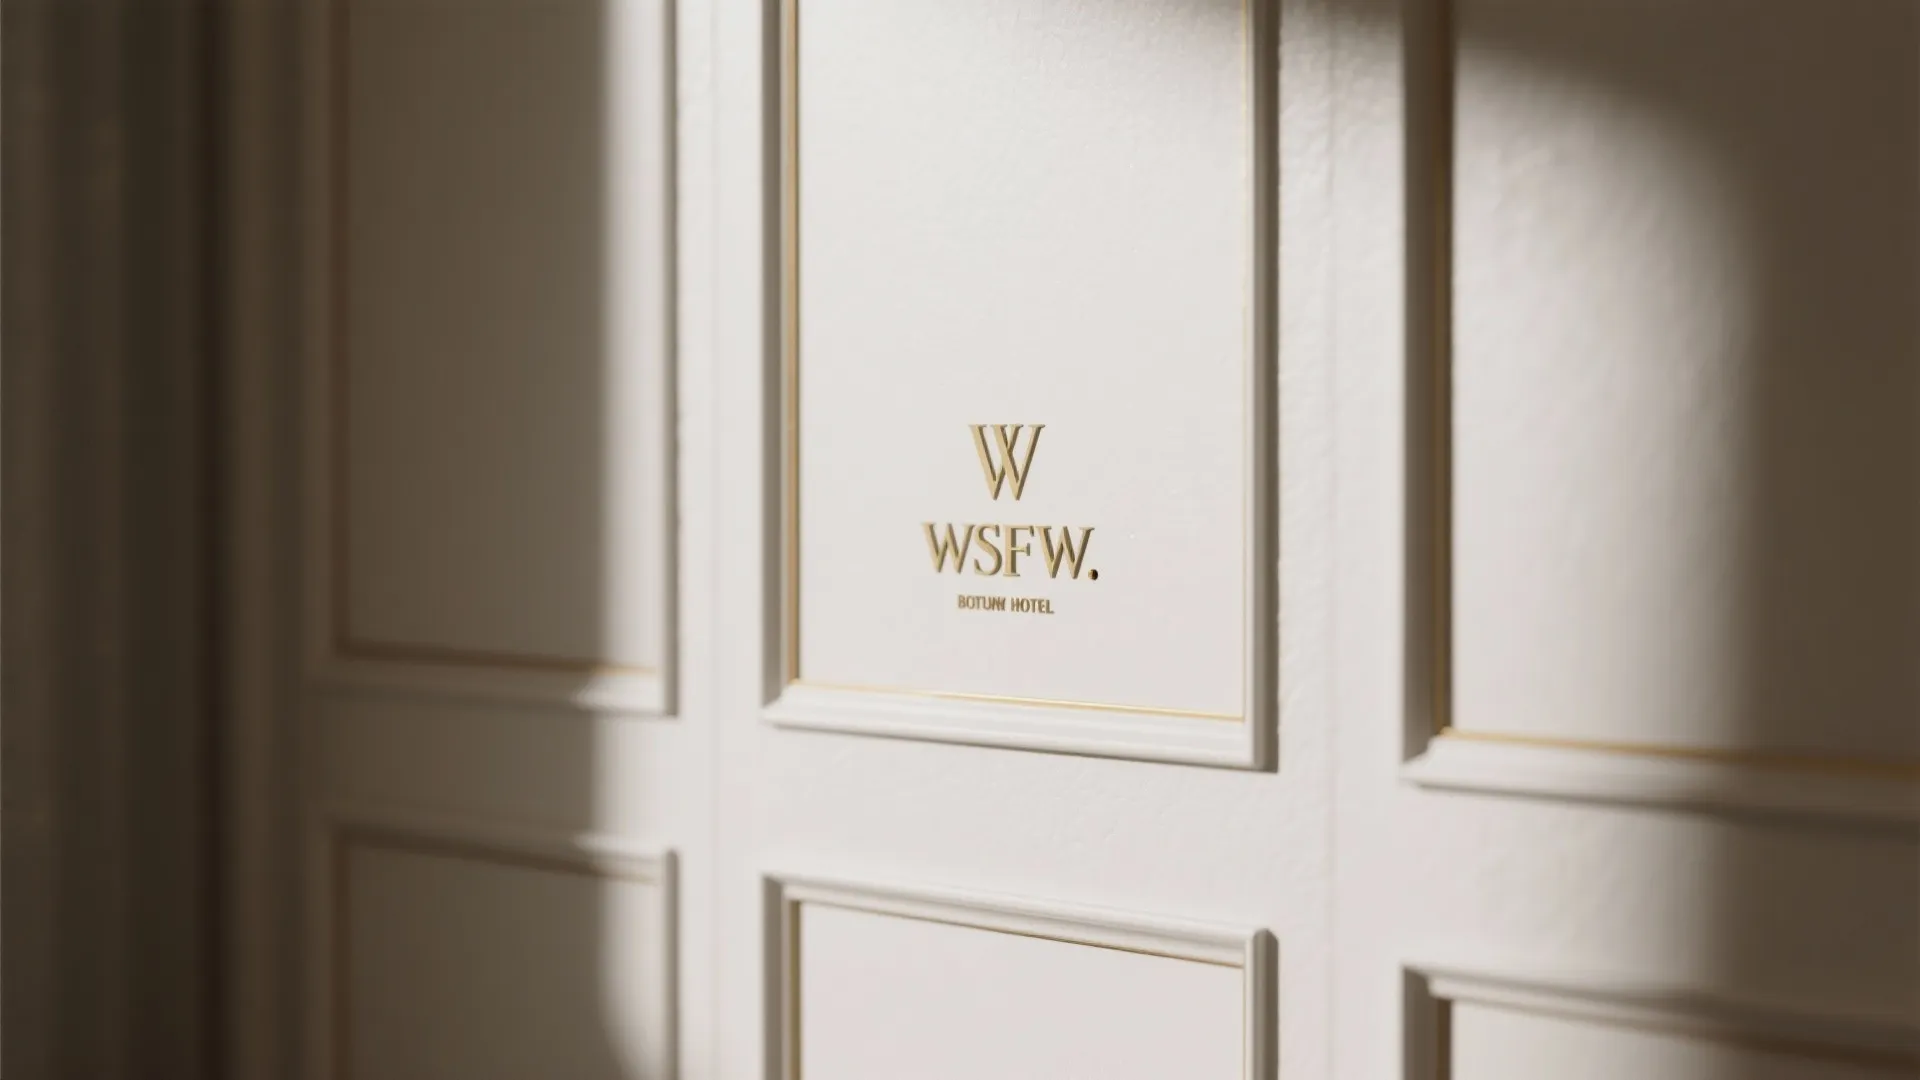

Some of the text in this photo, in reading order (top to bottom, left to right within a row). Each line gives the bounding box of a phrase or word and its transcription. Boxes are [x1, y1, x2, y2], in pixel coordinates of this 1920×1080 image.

[970, 424, 1045, 501] W
[921, 522, 1099, 581] WSFW.
[1010, 597, 1055, 614] HOTEL
